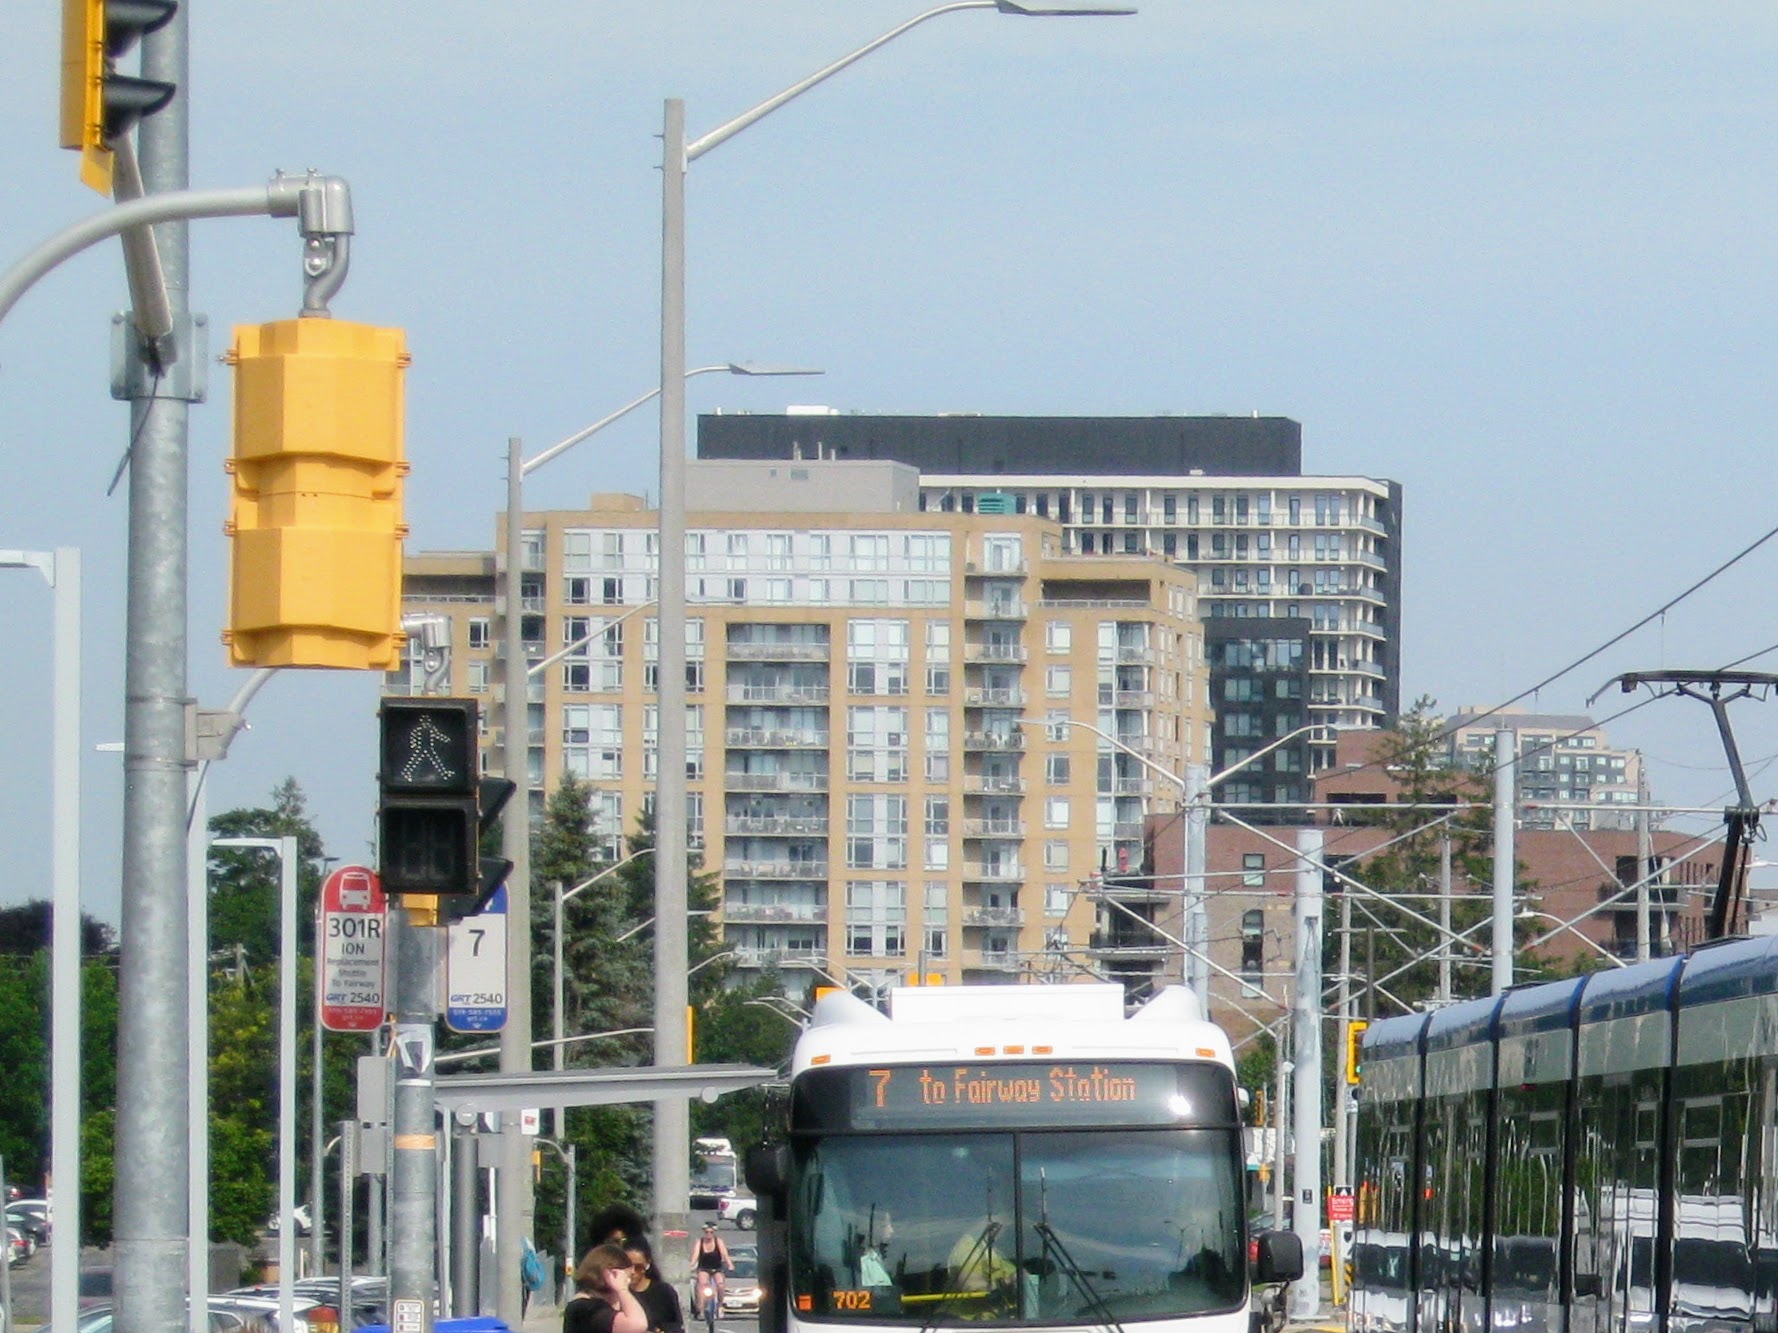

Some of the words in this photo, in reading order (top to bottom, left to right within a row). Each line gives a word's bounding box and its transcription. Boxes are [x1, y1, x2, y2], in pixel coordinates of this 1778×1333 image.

[329, 918, 381, 938] 301R
[341, 943, 365, 955] ION
[468, 929, 485, 957] 7
[344, 979, 375, 989] Fairway
[327, 993, 348, 1001] GRT
[350, 992, 380, 1004] 2540
[451, 994, 472, 1002] GRT
[473, 993, 503, 1004] 2540
[868, 1070, 891, 1107] 7
[920, 1069, 945, 1104] to
[954, 1069, 1040, 1104] Fairway
[1049, 1067, 1136, 1102] Station
[832, 1290, 871, 1309] 702
